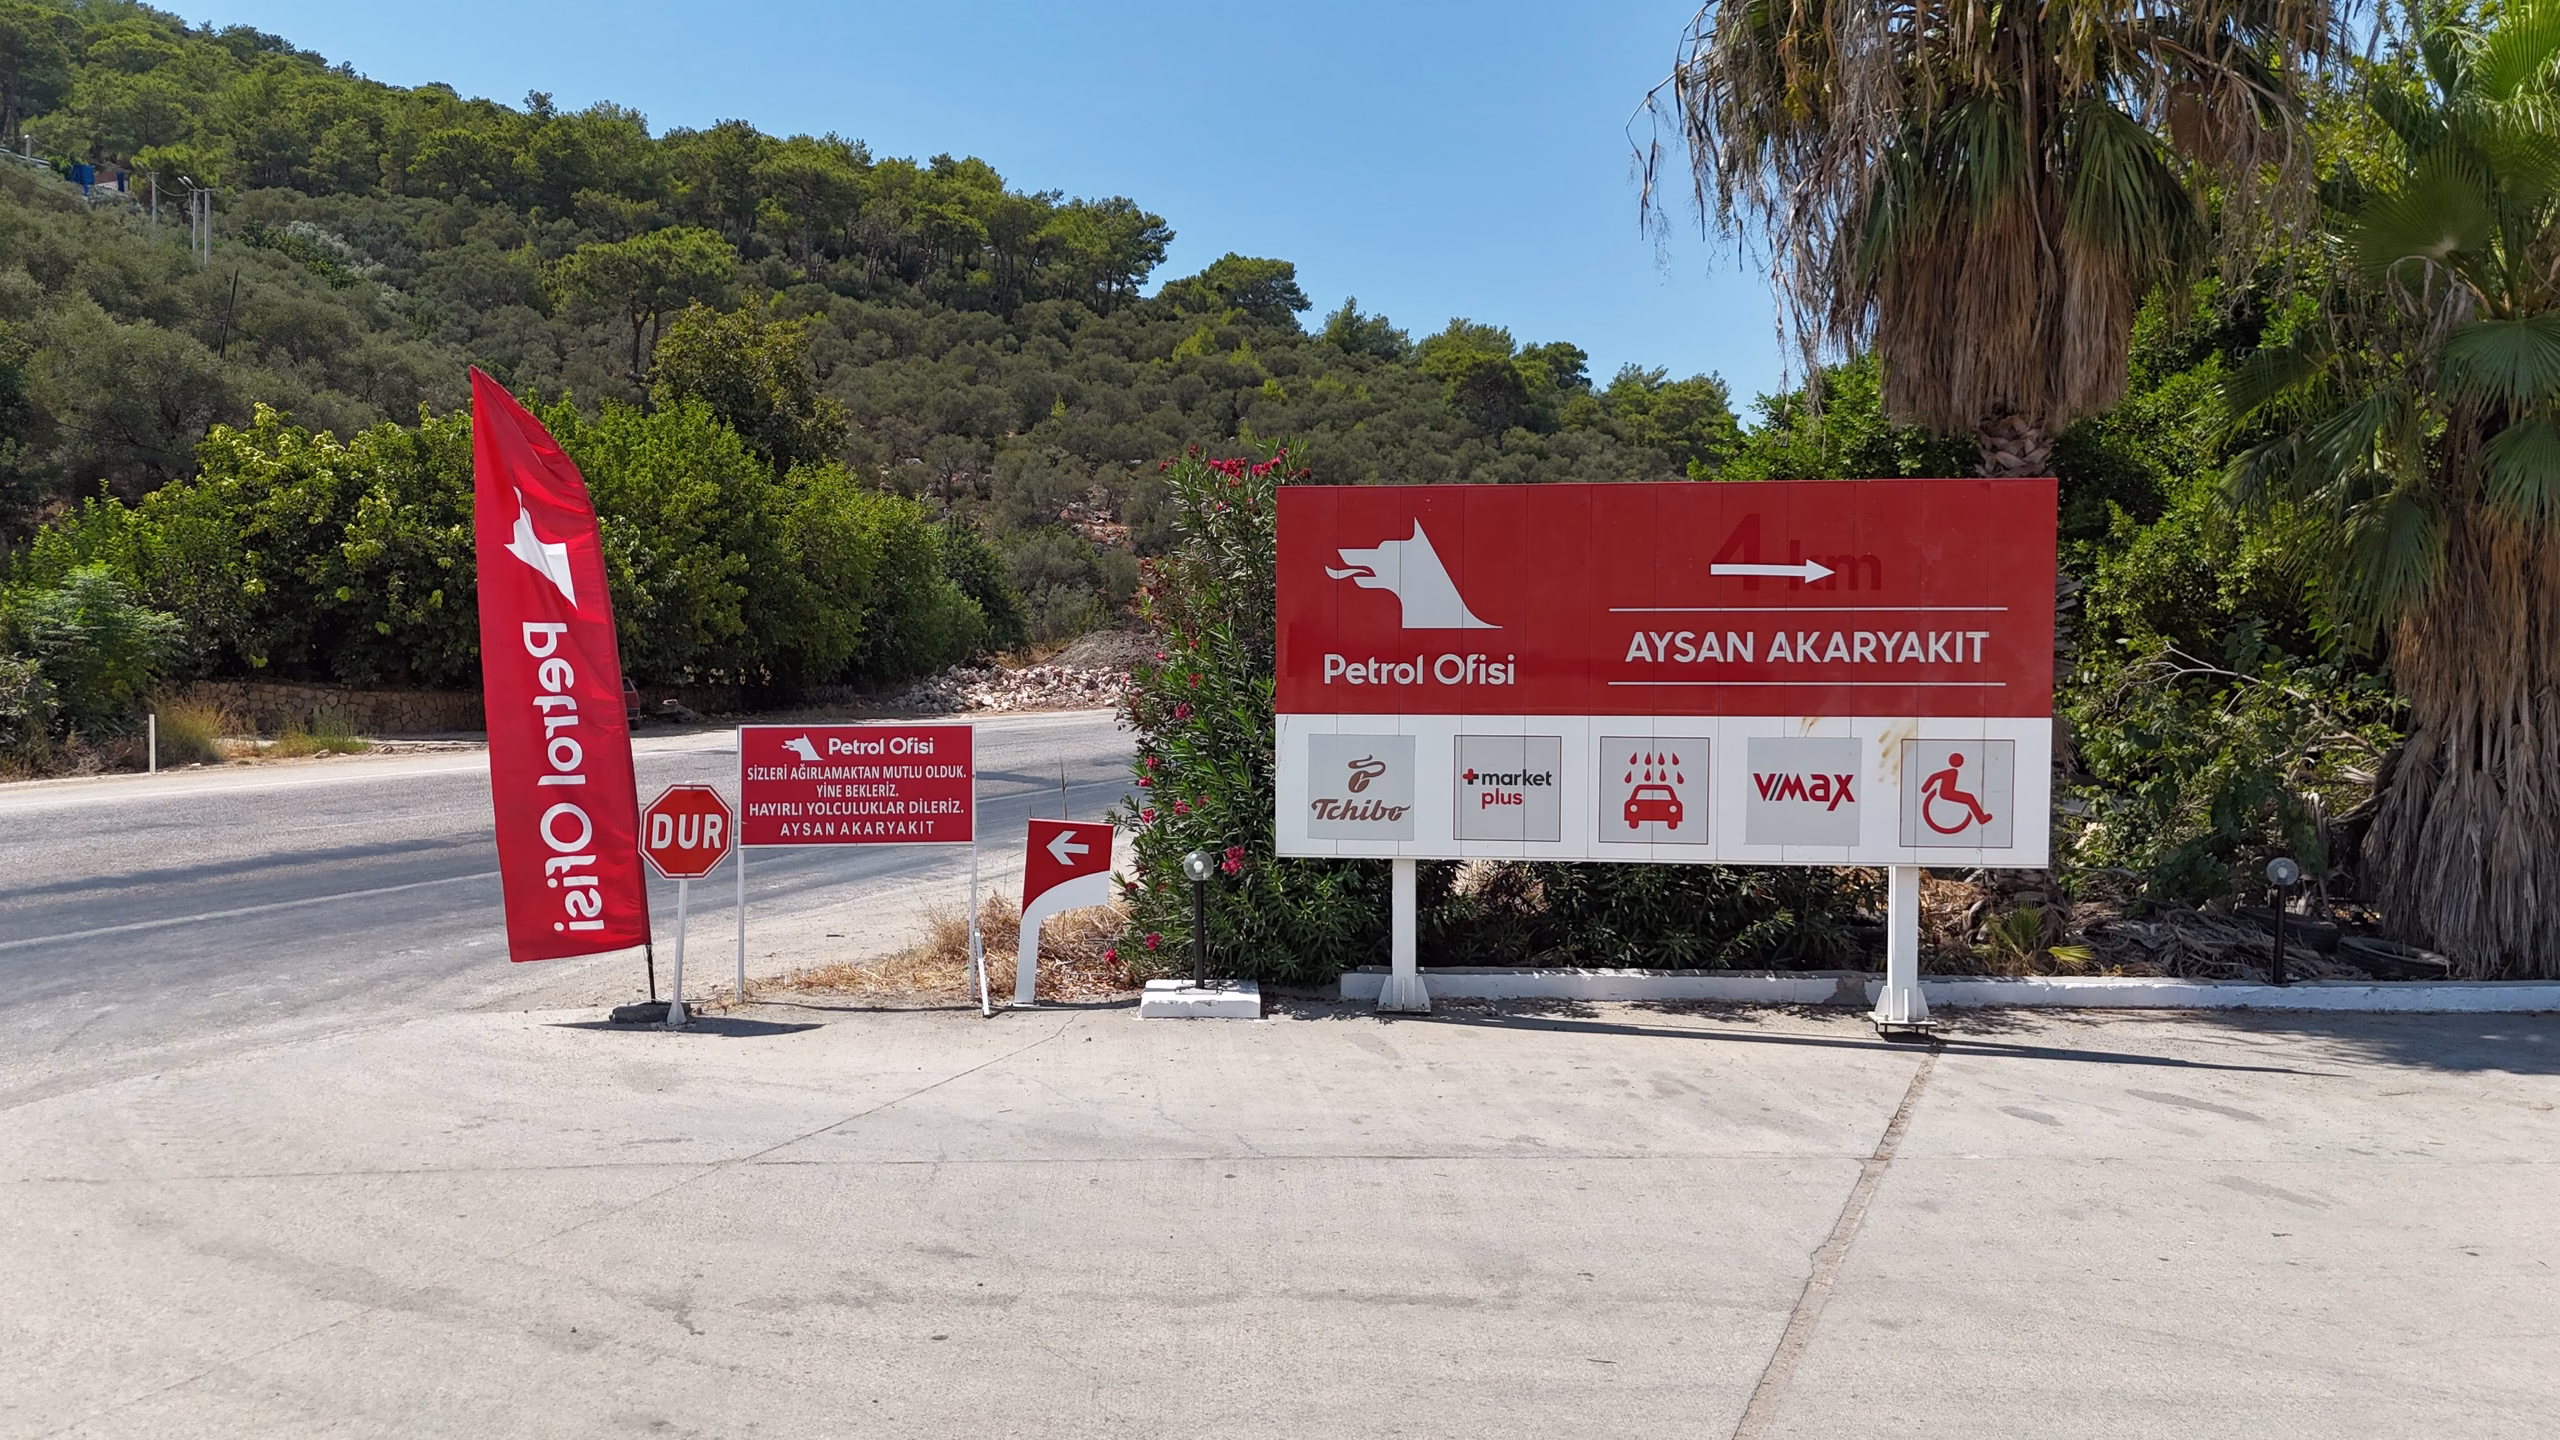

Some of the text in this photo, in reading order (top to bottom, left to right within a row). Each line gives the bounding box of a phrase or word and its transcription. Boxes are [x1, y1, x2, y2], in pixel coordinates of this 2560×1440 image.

[1624, 631, 1990, 664] AYSAN AKARYAKIT
[1323, 653, 1515, 685] Petrol Ofisi
[828, 737, 934, 755] Petrol Ofisi
[747, 763, 967, 780] SİZLERİ AĞIRLAMAKTAN MUTLU OLDUK.
[816, 781, 899, 798] YİNE BEKLERİZ.
[1480, 788, 1524, 810] plus
[749, 797, 964, 816] HAYIRLI YOLCULUKLAR DİLERİZ.
[1310, 797, 1411, 823] Tchibo
[650, 812, 723, 850] DUR
[780, 820, 934, 837] AYSAN AKARYAKIT
